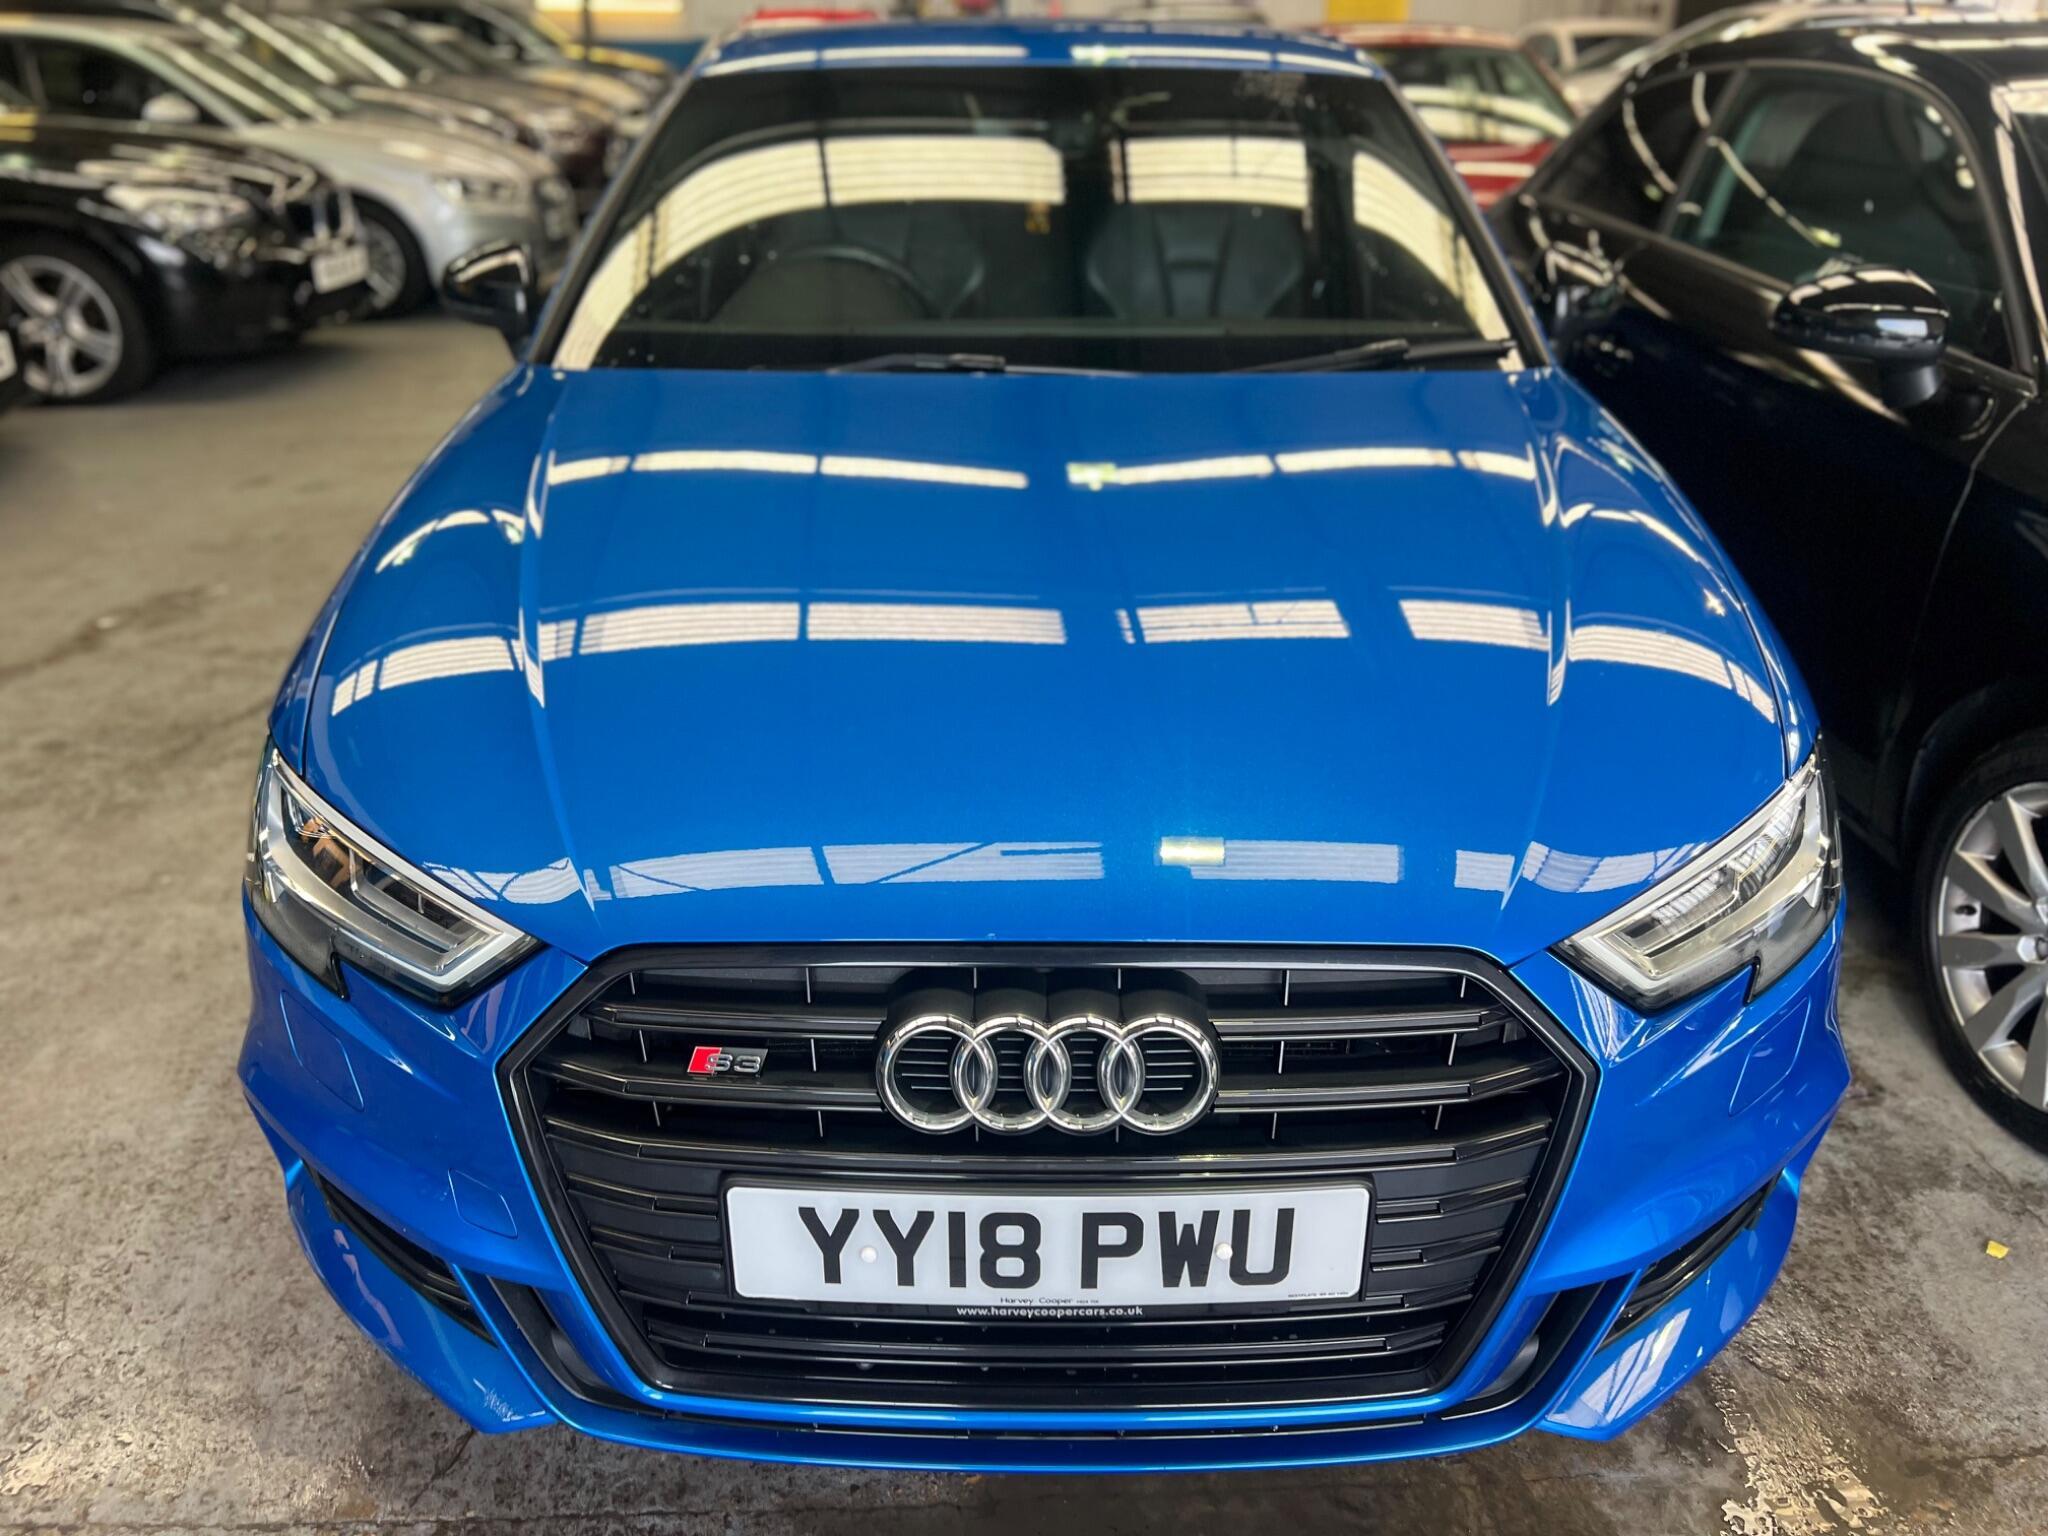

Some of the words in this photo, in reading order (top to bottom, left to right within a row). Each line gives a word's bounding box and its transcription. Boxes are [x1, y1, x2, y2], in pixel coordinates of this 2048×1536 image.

[704, 1053, 761, 1073] S3
[798, 1207, 1042, 1289] YY18
[1079, 1207, 1295, 1289] PWU
[1000, 1297, 1033, 1305] Harvey
[1039, 1297, 1073, 1305] Cooper
[956, 1306, 1143, 1318] www.harveycoopercars.co.uk
